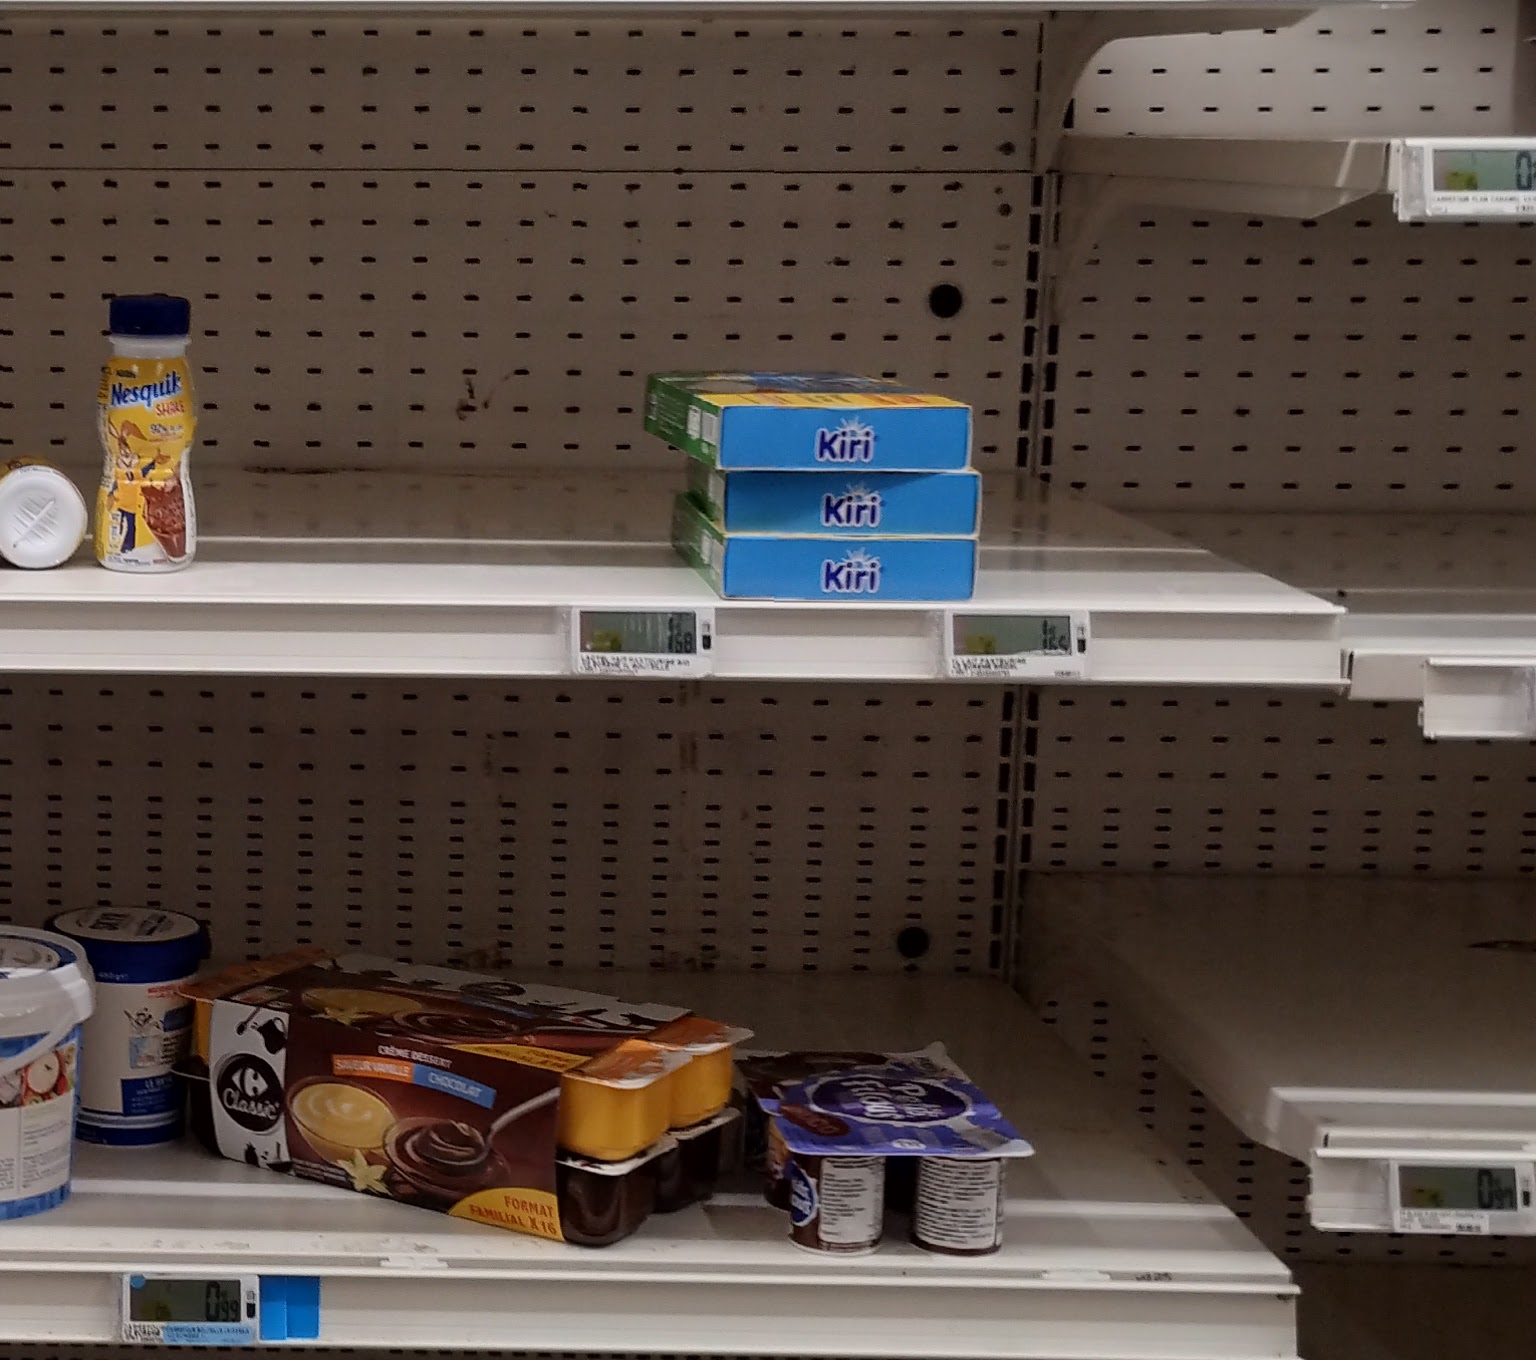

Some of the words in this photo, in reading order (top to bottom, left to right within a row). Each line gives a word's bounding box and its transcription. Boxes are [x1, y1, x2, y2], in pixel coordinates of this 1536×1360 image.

[110, 371, 183, 409] Nesquik
[818, 429, 874, 461] Kiri
[824, 494, 880, 525] Kiri
[824, 559, 880, 591] Kiri
[427, 1072, 482, 1098] CHOCOLAT
[469, 1203, 524, 1227] FAMILIAL
[504, 1195, 555, 1217] FORMAT
